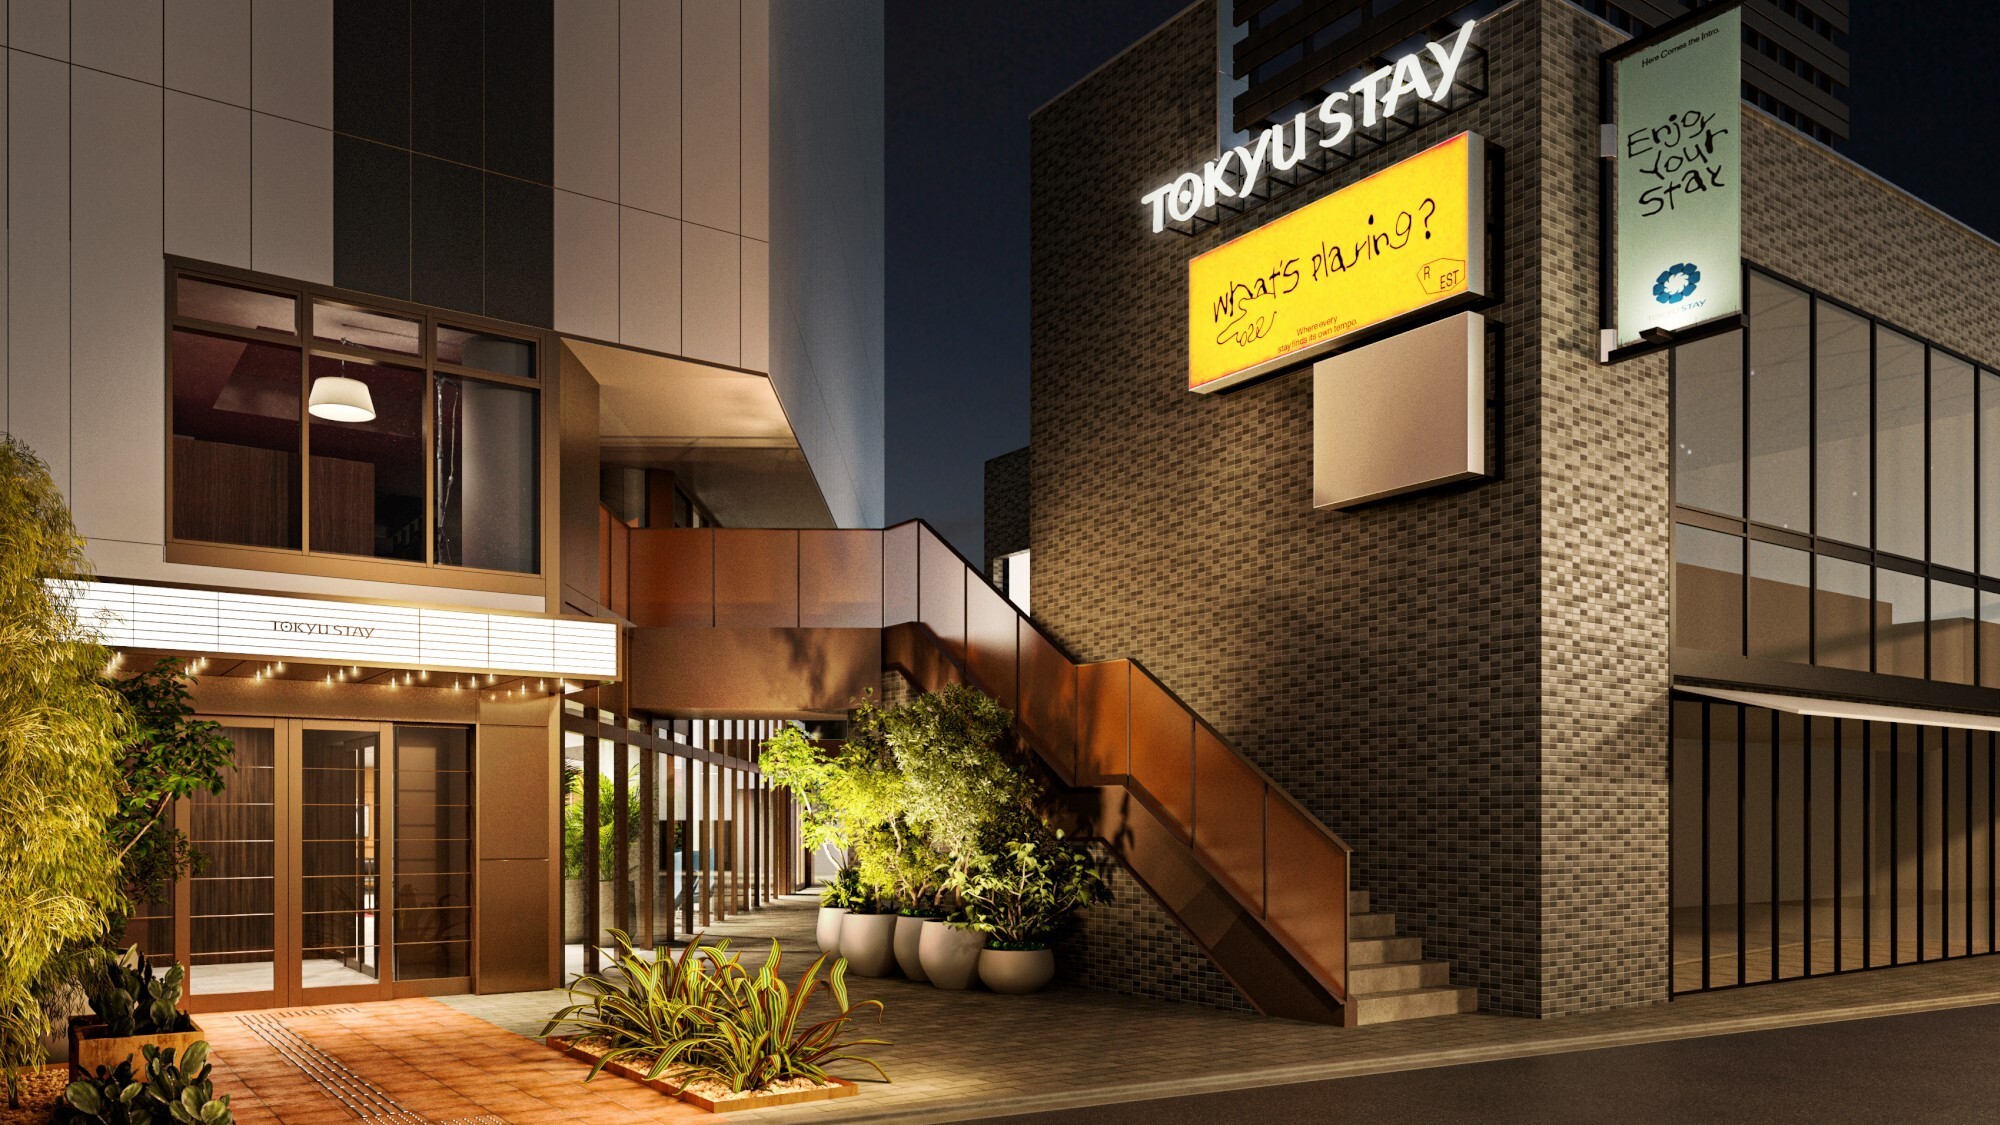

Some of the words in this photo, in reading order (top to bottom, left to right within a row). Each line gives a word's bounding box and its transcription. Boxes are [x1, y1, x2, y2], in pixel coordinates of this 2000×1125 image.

[1641, 55, 1659, 68] Here
[1660, 42, 1687, 59] Comes
[1688, 36, 1700, 46] the
[1701, 28, 1720, 41] Intro.
[1141, 112, 1306, 234] TOKYU
[1319, 19, 1477, 148] STAY
[1628, 110, 1716, 158] Enjoy
[1440, 269, 1459, 290] EST
[1681, 299, 1707, 312] STAY
[1296, 323, 1318, 336] Where
[1318, 316, 1338, 328] every
[1277, 342, 1292, 354] stay
[1291, 337, 1307, 348] finds
[1308, 333, 1317, 341] its
[1317, 328, 1333, 339] own
[272, 620, 329, 636] TOKYU
[333, 624, 376, 639] STAY
